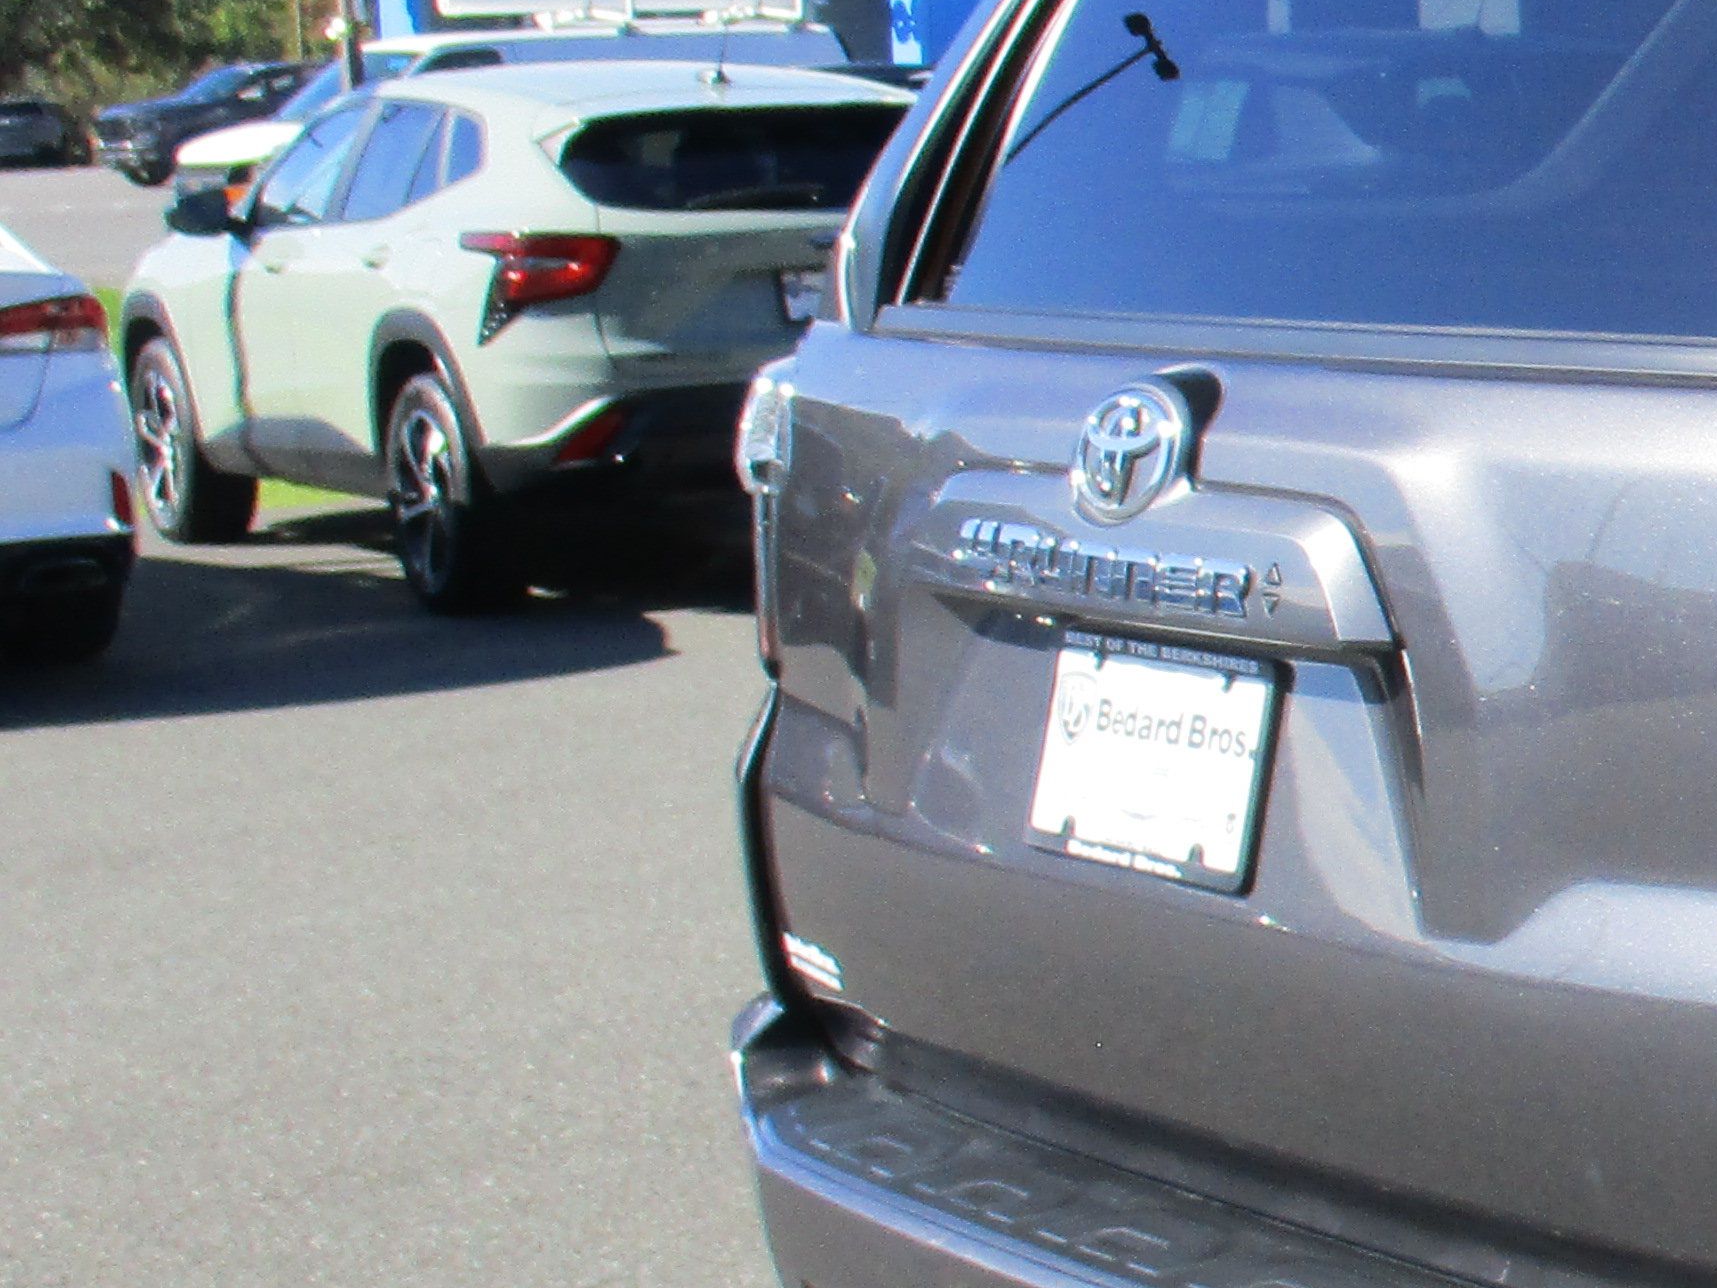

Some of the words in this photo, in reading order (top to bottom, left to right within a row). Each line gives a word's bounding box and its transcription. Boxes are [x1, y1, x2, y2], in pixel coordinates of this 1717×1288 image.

[1106, 638, 1126, 652] OF
[1126, 640, 1159, 658] THE
[1096, 698, 1186, 746] Bedard
